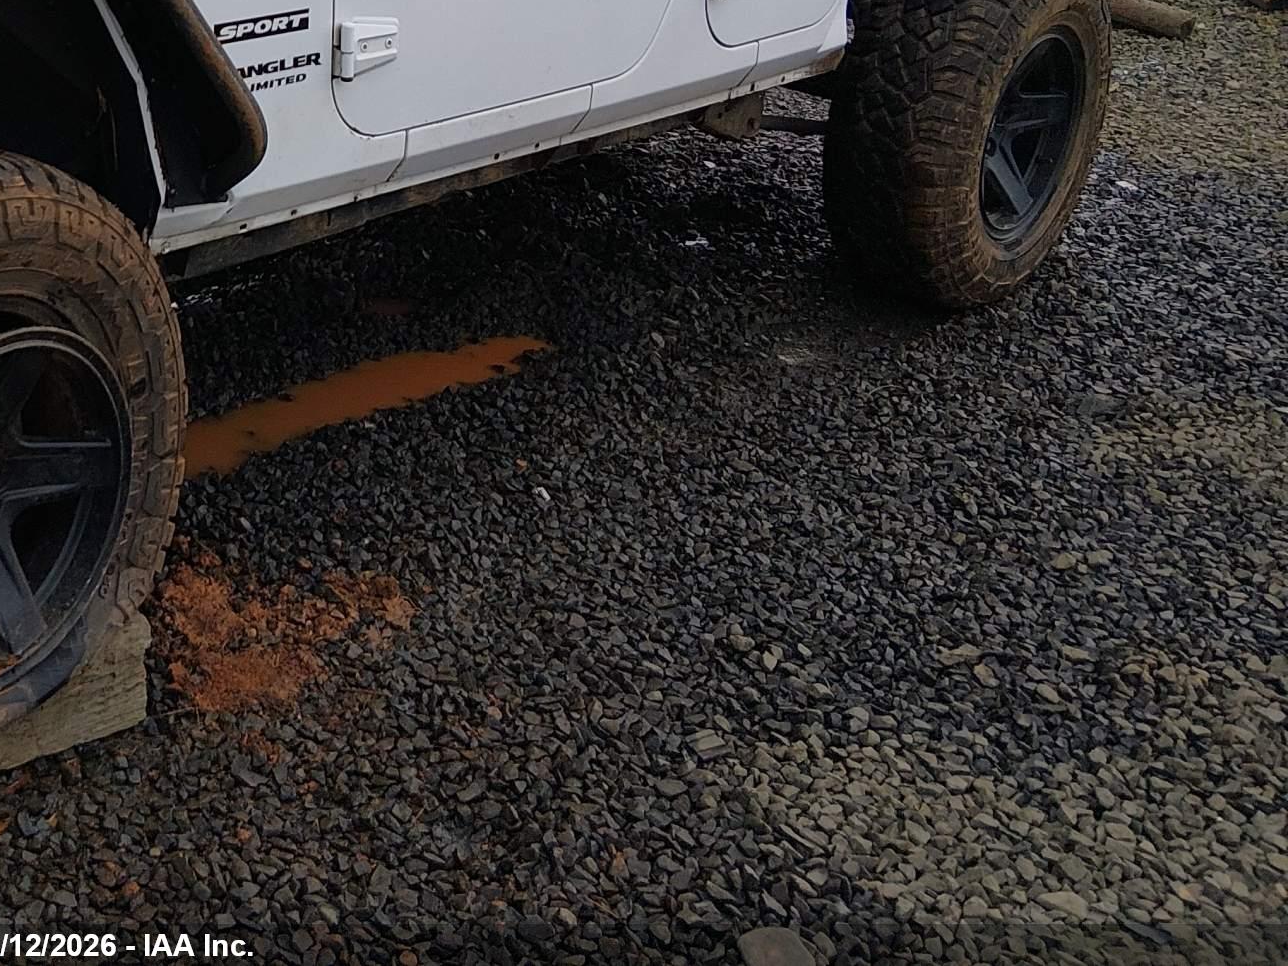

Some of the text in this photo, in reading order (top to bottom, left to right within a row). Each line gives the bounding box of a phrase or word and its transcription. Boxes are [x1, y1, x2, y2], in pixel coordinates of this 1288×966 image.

[216, 13, 309, 42] SPORT
[237, 53, 321, 78] ANGLER
[250, 73, 307, 92] IMITED
